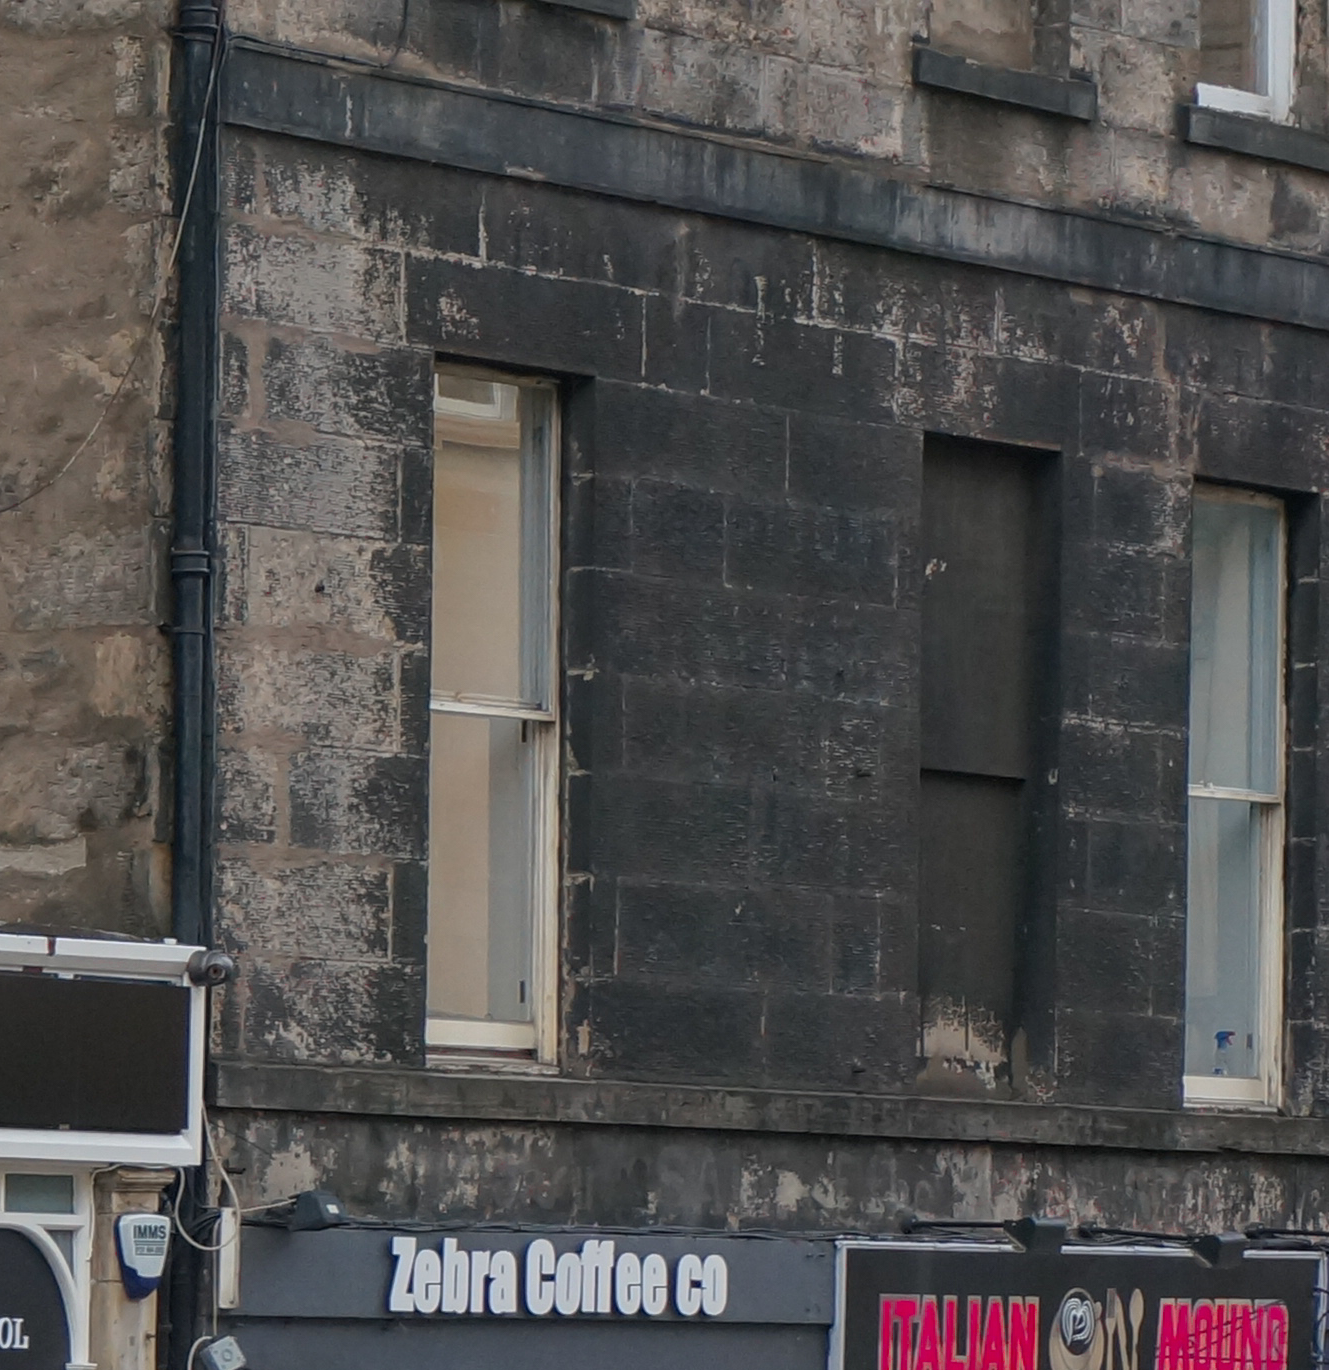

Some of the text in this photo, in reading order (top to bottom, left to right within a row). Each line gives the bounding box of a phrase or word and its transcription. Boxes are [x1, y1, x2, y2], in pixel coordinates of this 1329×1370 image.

[133, 1225, 166, 1239] IMMS
[389, 1236, 727, 1316] Zebra Coffee co
